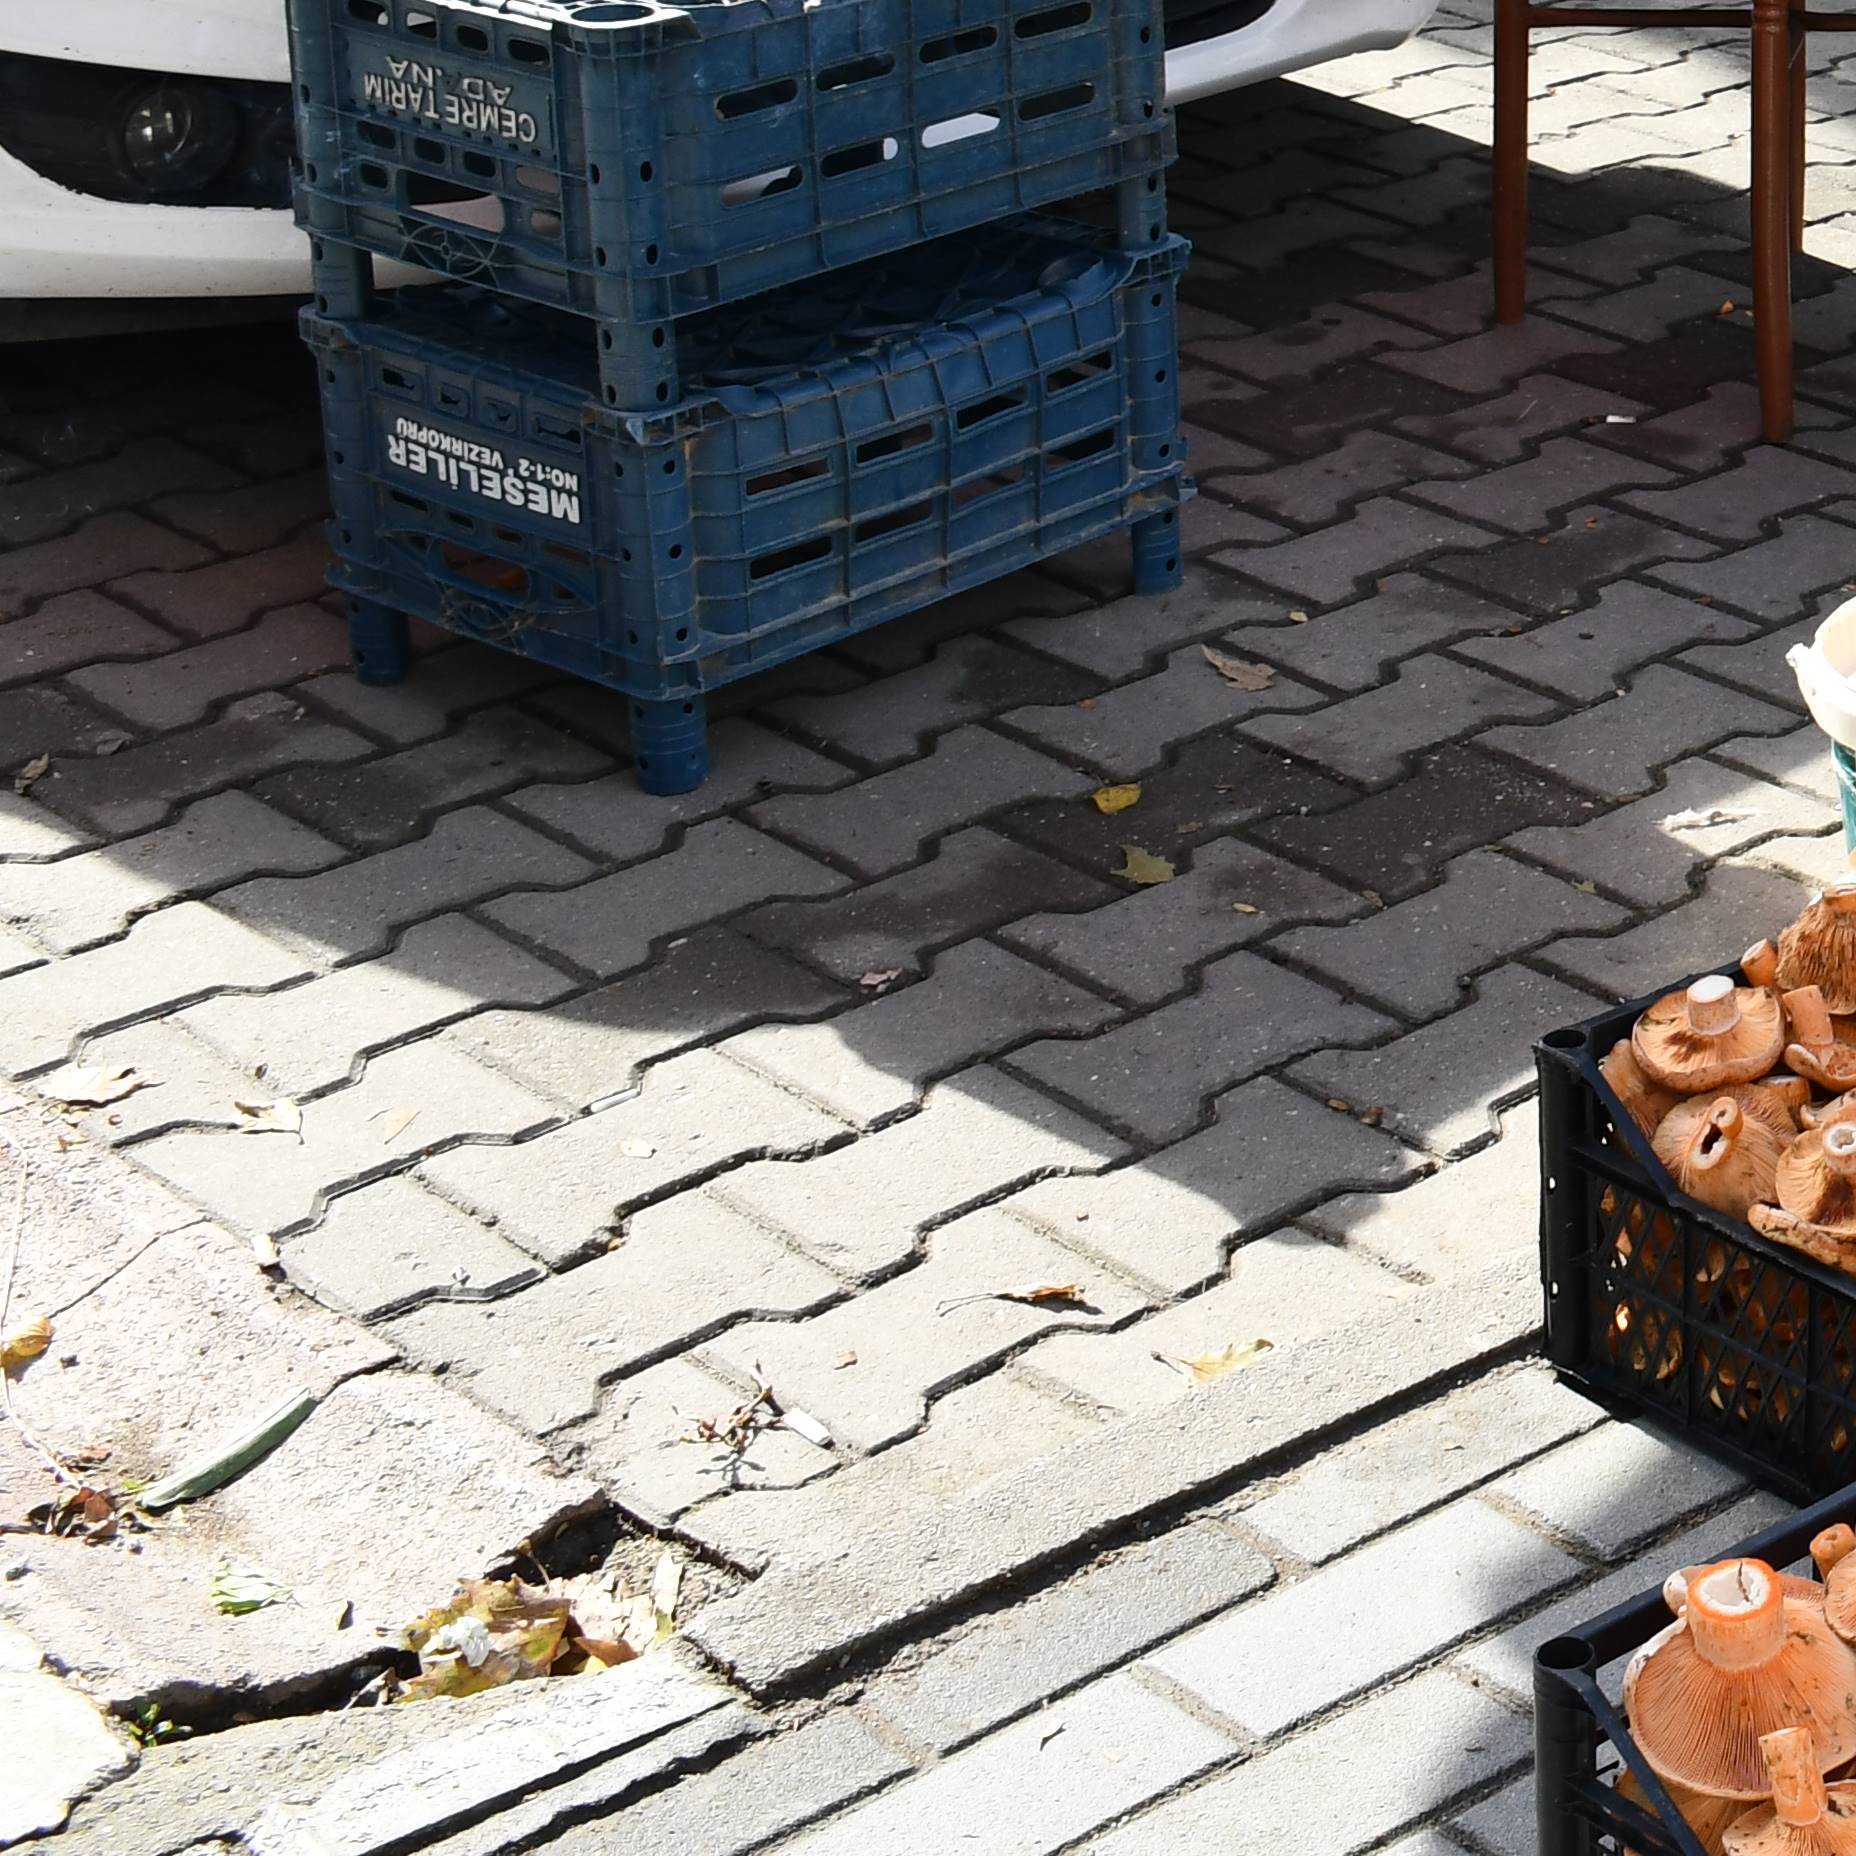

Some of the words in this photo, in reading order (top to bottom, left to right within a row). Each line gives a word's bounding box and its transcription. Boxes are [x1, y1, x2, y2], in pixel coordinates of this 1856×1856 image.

[363, 73, 441, 120] TARIM
[444, 94, 537, 143] CEMRE
[387, 434, 581, 525] MEŞELİLER
